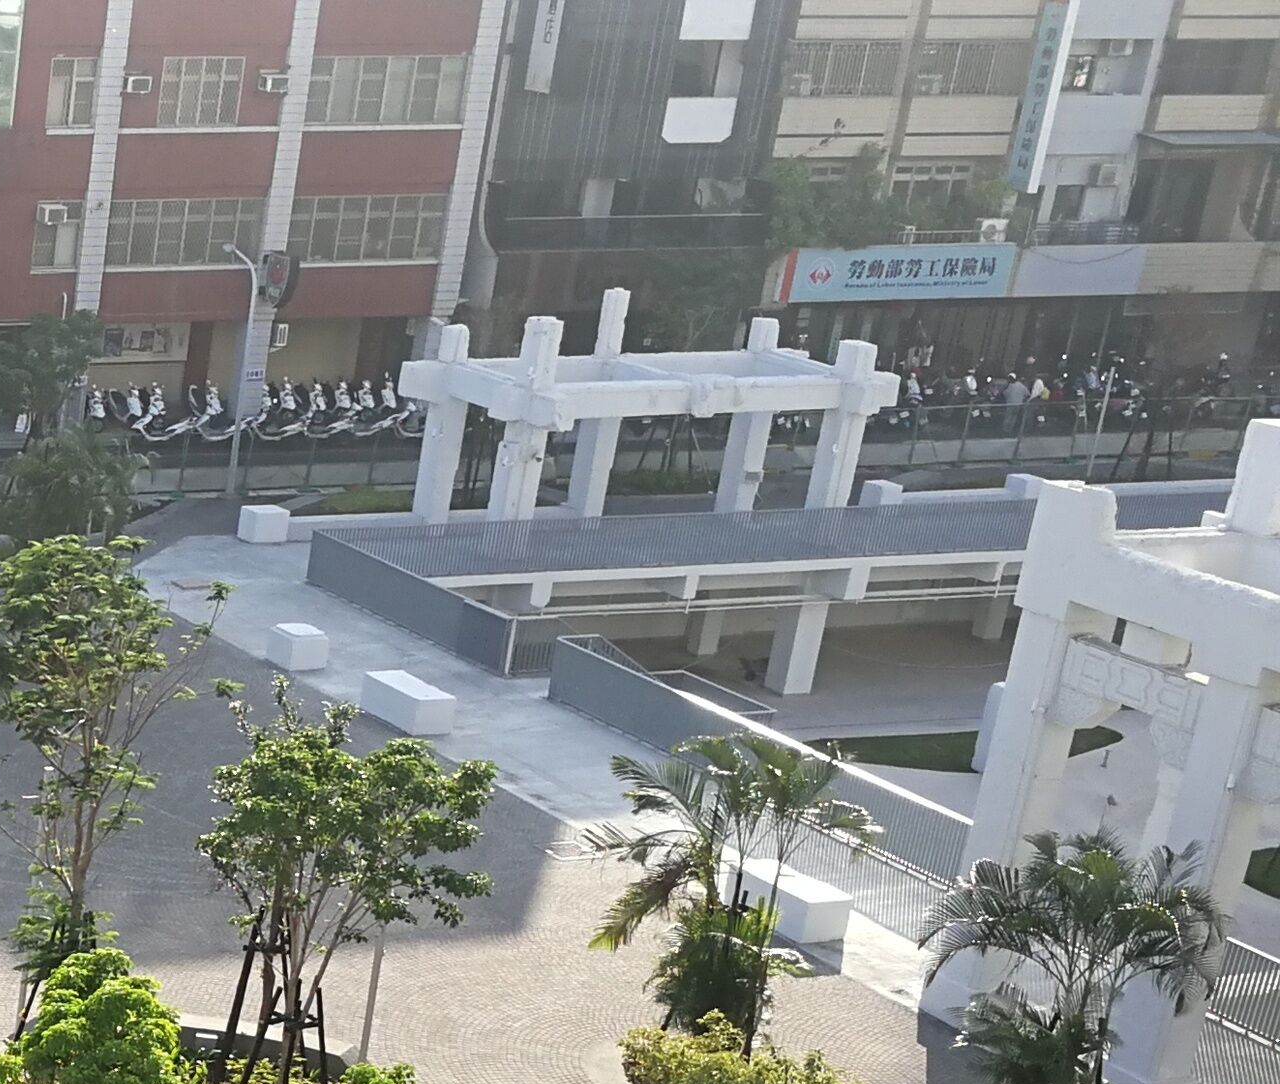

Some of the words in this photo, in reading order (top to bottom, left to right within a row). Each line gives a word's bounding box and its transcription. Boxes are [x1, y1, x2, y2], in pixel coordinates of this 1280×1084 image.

[848, 257, 997, 280] 勞動部勞工保險局
